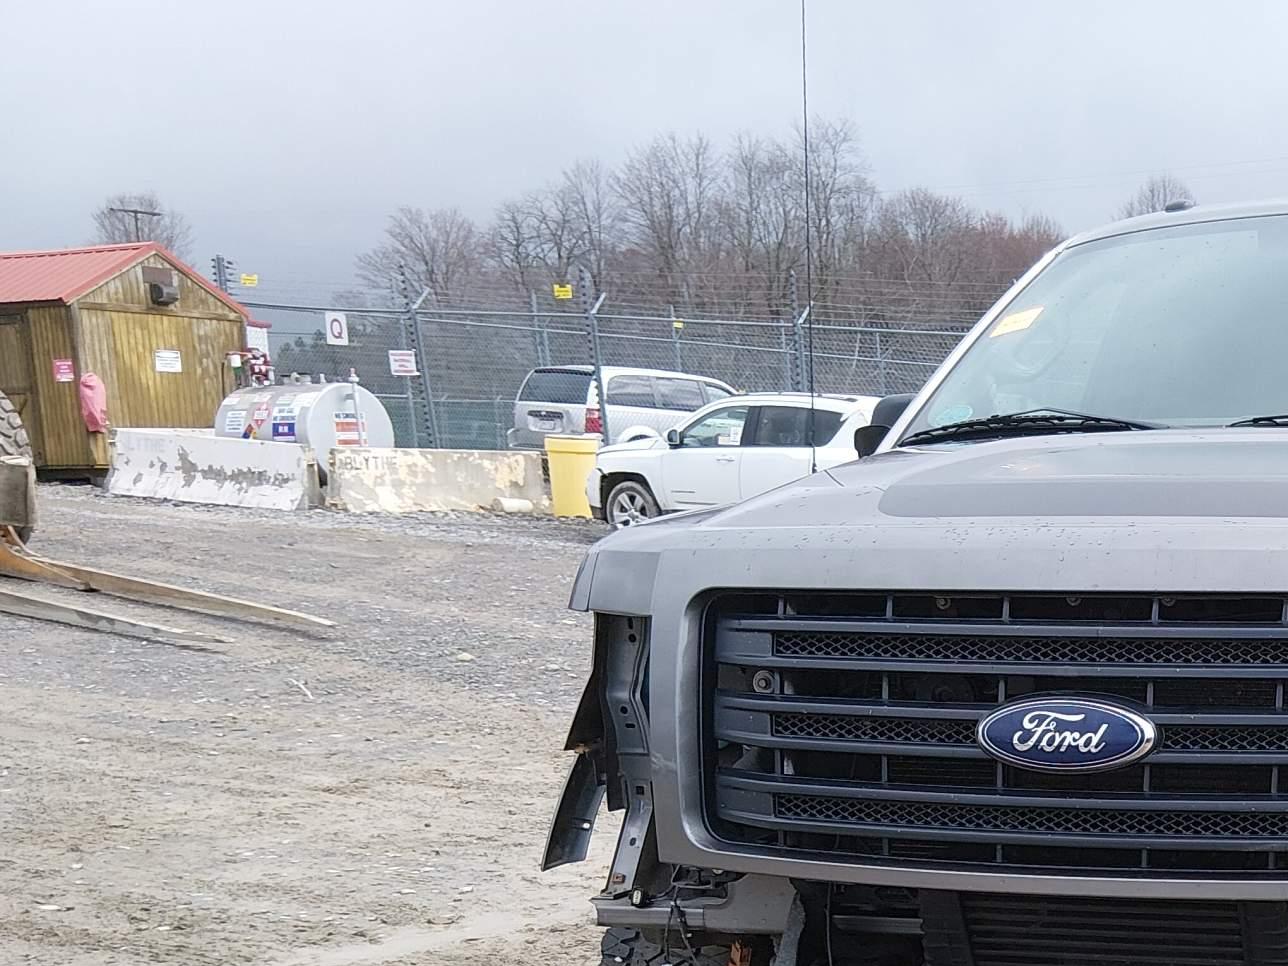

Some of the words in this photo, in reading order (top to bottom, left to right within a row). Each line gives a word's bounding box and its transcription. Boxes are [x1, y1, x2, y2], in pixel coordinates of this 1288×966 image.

[330, 318, 344, 339] Q
[344, 456, 397, 470] BLYTHE
[1013, 711, 1108, 753] Ford
